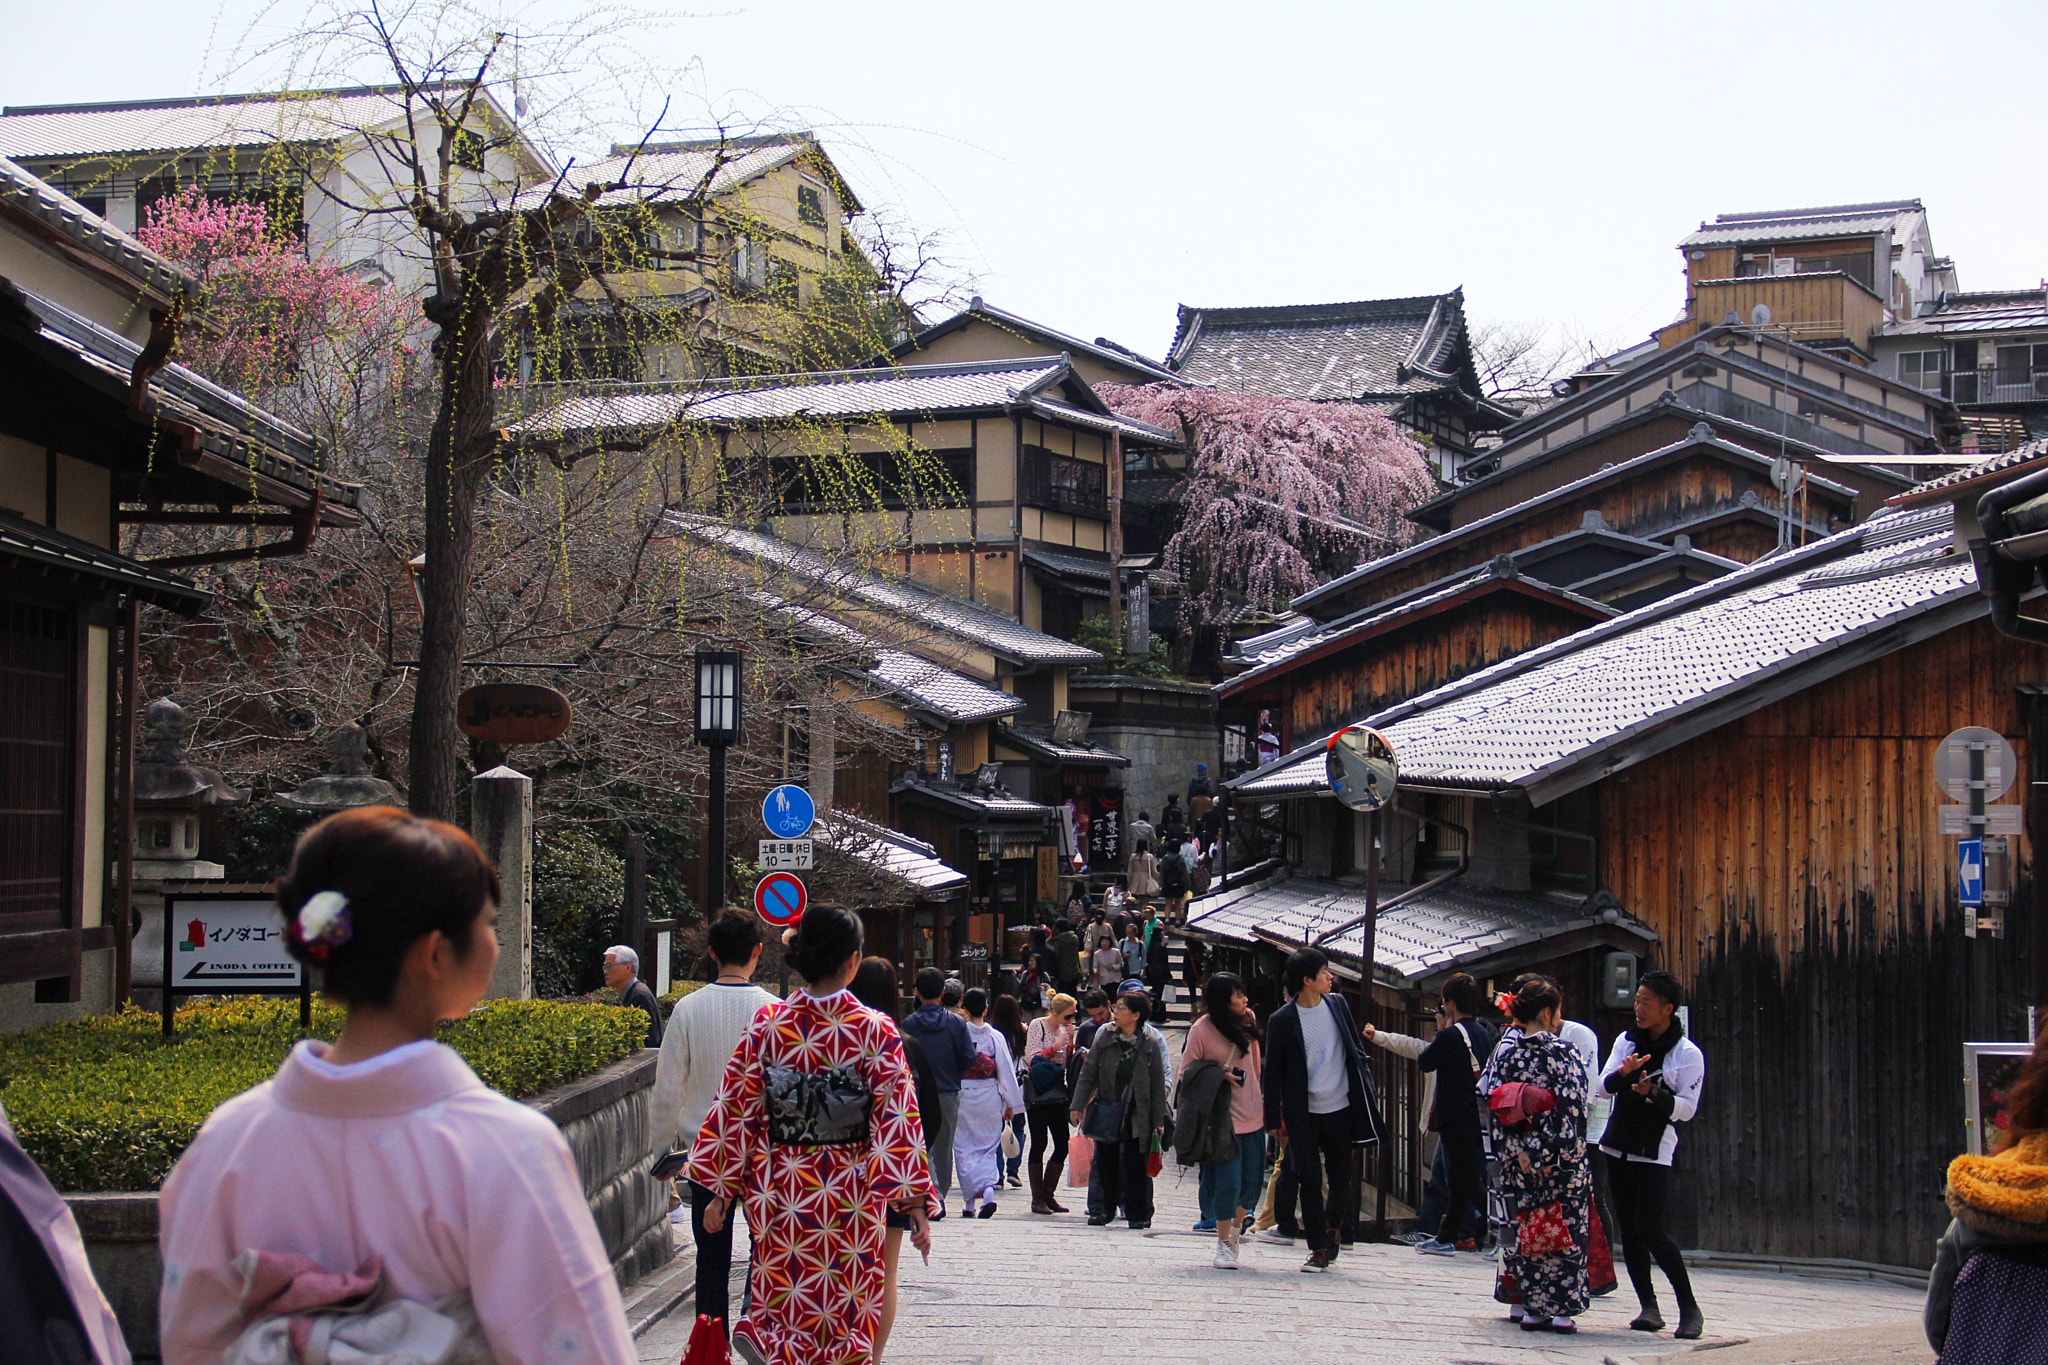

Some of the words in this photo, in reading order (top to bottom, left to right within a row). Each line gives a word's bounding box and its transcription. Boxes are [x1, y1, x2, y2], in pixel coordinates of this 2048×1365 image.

[1104, 810, 1119, 859] 世界一辛い
[960, 947, 987, 958] エンドウ
